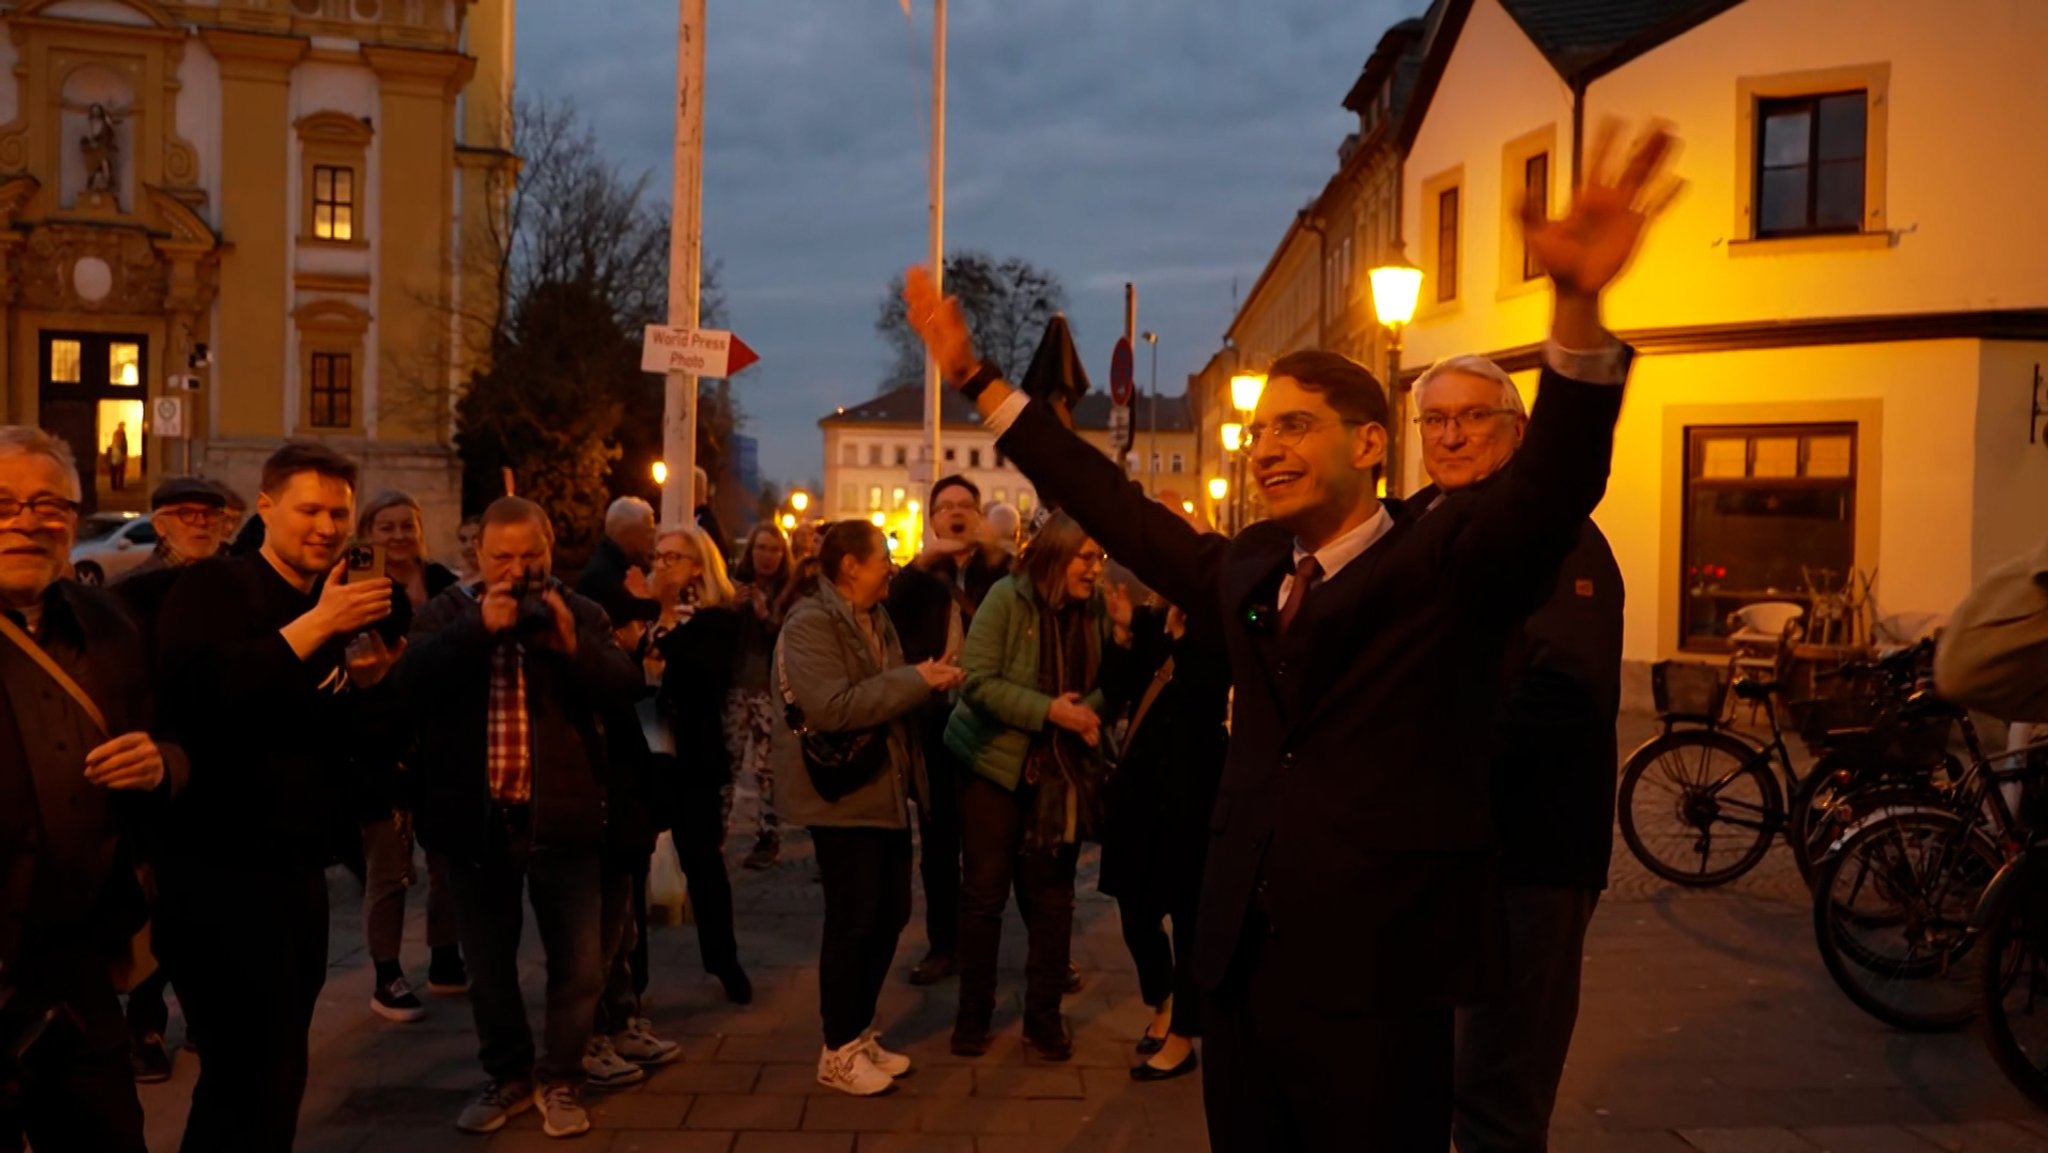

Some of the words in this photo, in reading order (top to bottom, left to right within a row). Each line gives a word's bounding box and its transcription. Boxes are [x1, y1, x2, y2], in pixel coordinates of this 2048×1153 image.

[654, 331, 688, 347] World
[693, 334, 726, 350] Press
[671, 352, 705, 368] Photo
